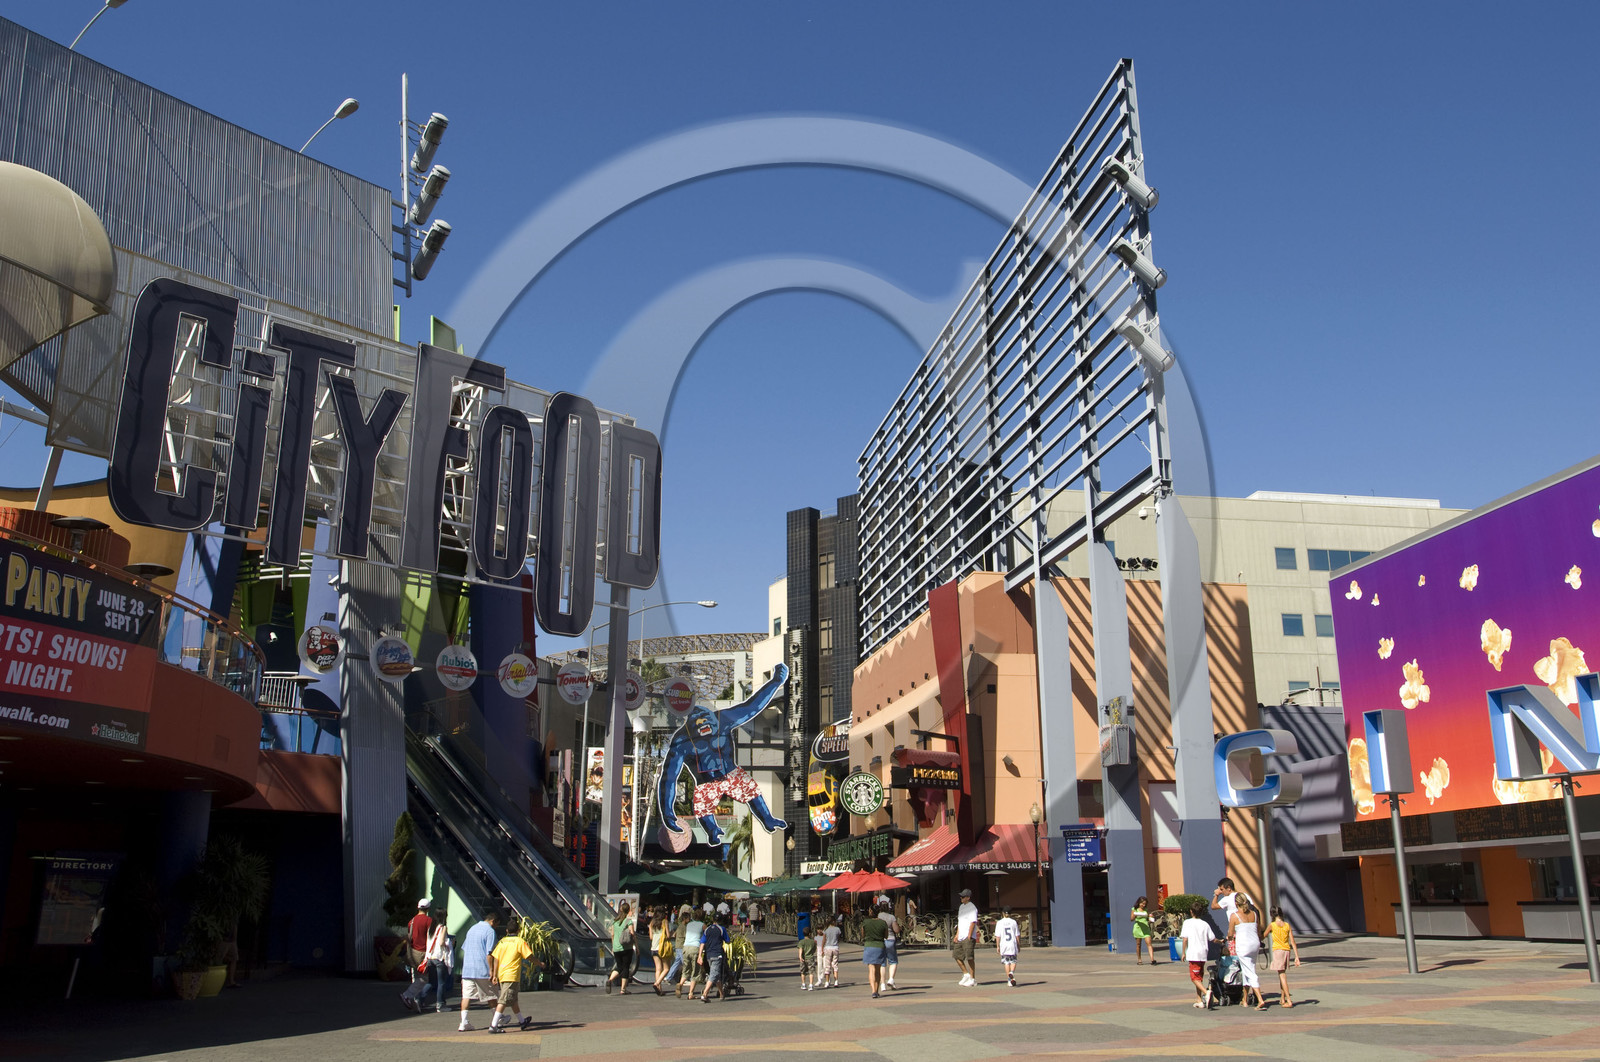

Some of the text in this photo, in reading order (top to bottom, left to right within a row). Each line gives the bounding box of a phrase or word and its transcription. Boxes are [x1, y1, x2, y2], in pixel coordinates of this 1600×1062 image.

[5, 552, 92, 622] PARTY
[97, 590, 127, 613] JUNE
[130, 598, 145, 617] 28
[104, 611, 140, 635] SEPT 1
[323, 633, 342, 641] KFC
[48, 633, 127, 671] SHOWS!
[442, 655, 475, 669] Rubio's
[5, 659, 73, 693] NIGHT.
[665, 688, 695, 699] SUBWAY
[788, 641, 802, 788] CITYWALK
[100, 724, 140, 744] Heineken
[845, 775, 881, 795] STARBUCKS
[850, 801, 878, 812] COFFEE
[53, 861, 114, 870] DIRECTORY
[806, 862, 825, 873] Racing
[1004, 927, 1012, 942] 5
